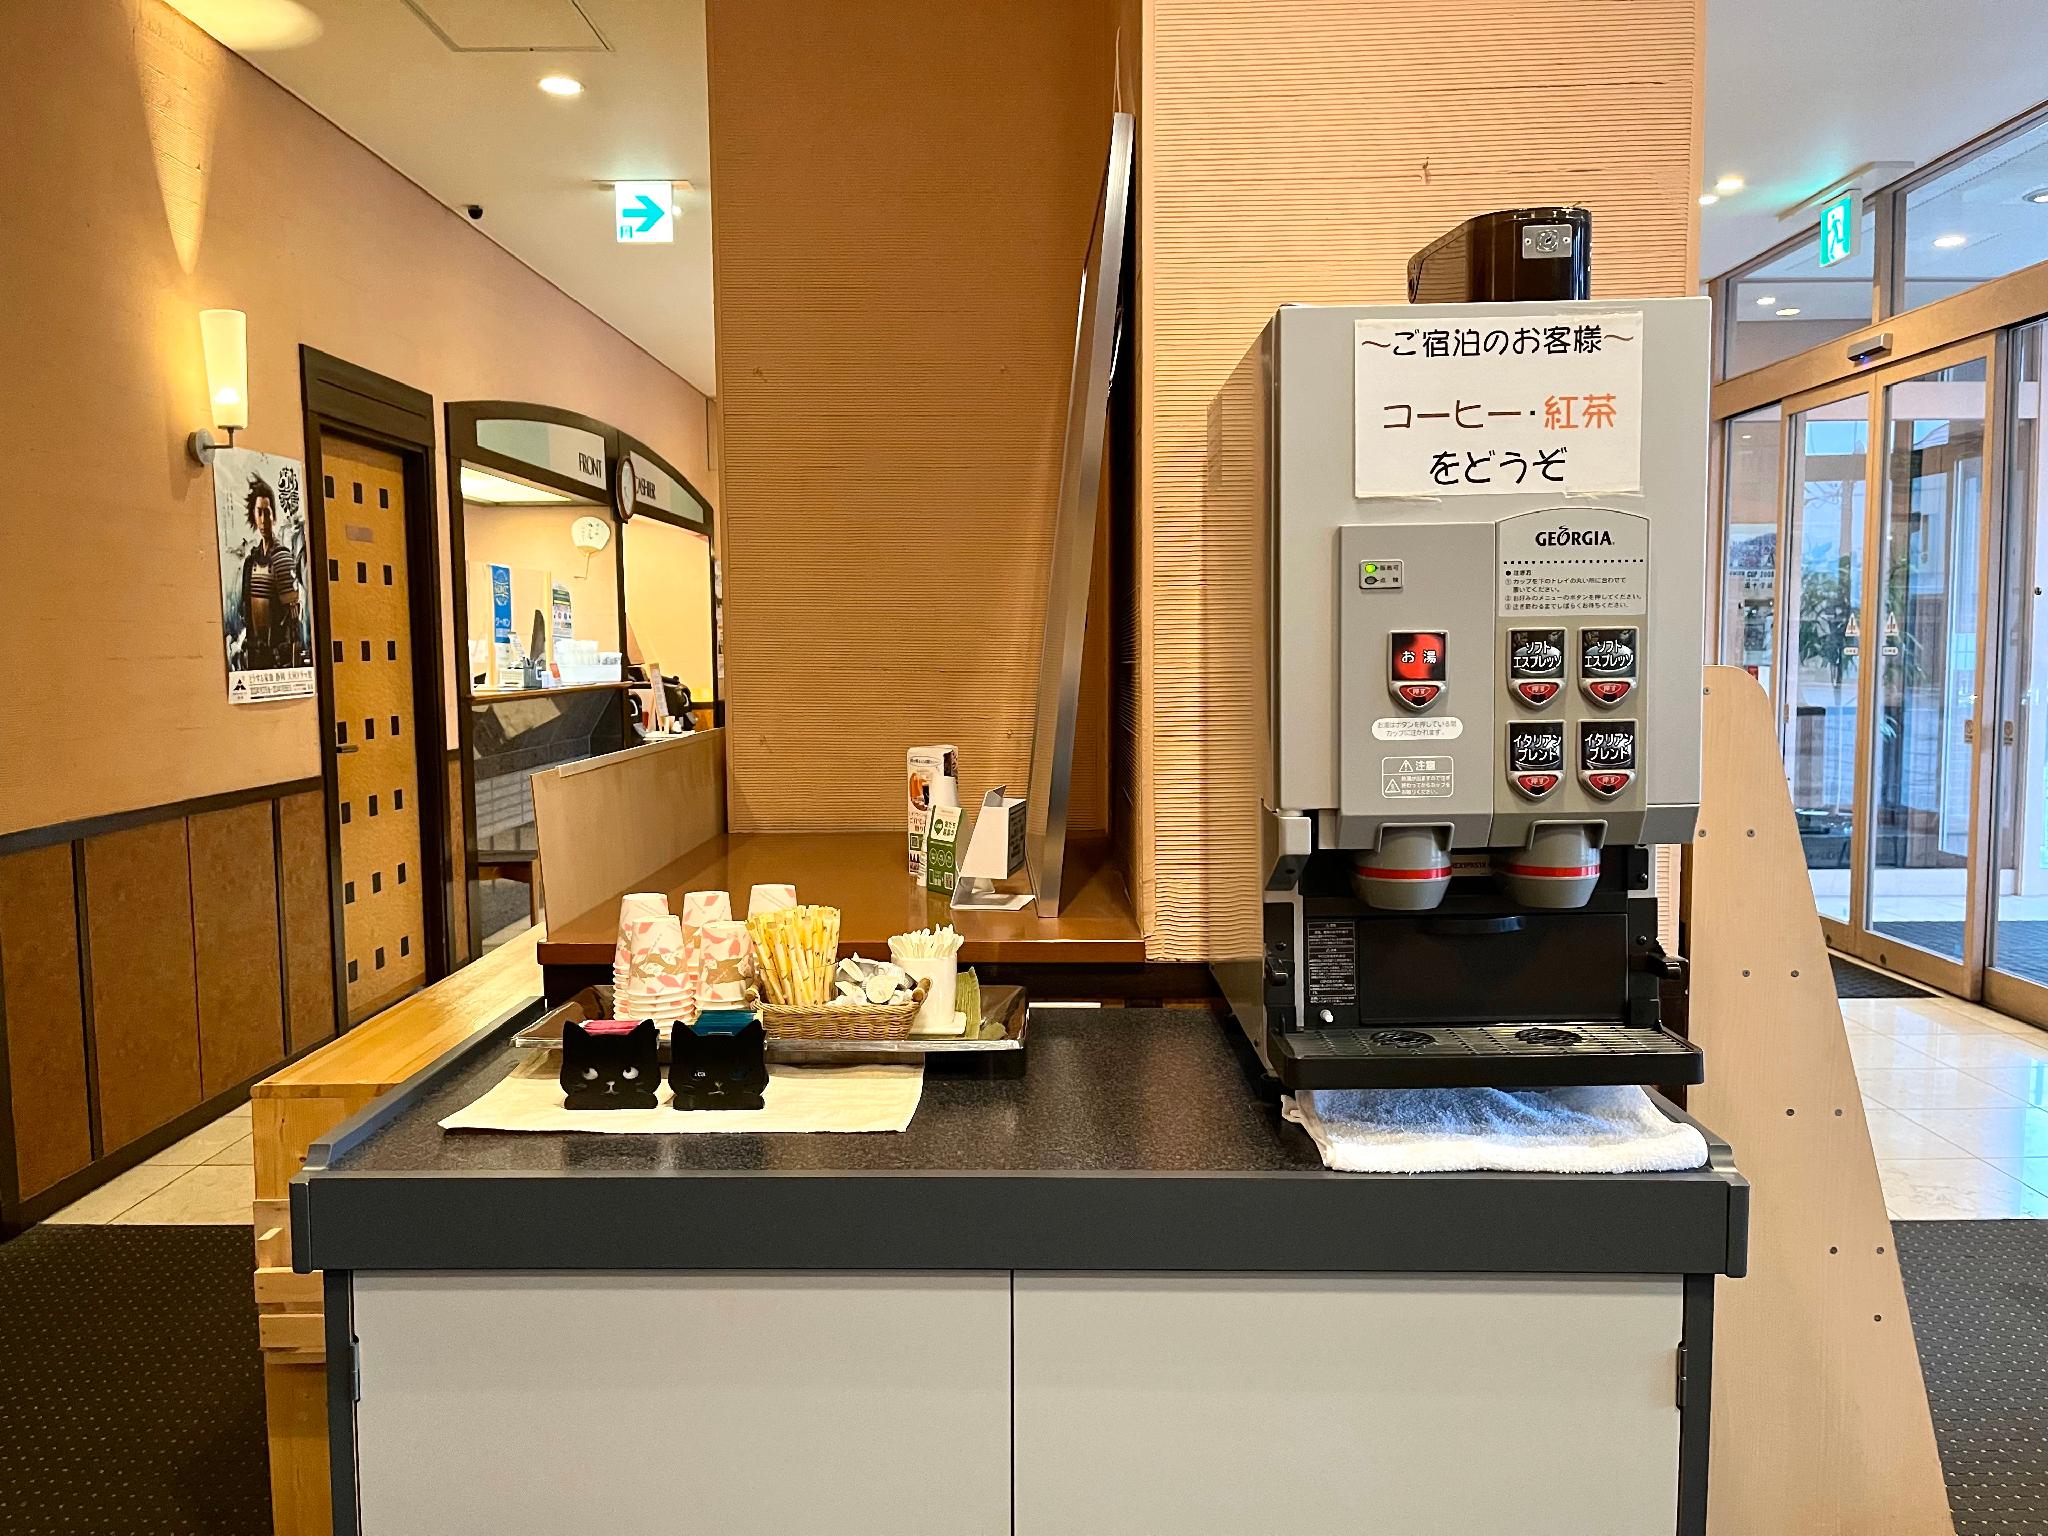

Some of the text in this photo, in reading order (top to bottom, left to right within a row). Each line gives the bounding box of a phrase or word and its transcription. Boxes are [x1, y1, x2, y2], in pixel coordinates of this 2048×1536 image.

[1384, 393, 1617, 430] コーヒー・紅茶
[578, 452, 602, 479] FRONT
[1430, 447, 1567, 485] をどうぞ
[1535, 525, 1613, 547] GEORGIA
[1525, 640, 1551, 654] ソフト
[1597, 639, 1622, 653] ソフト
[1401, 650, 1437, 664] お湯
[1513, 655, 1562, 668] エスプレッソ
[1584, 654, 1634, 668] エスプレッソ
[1513, 733, 1562, 748] イタリアン
[1584, 732, 1634, 747] イタリアン
[1518, 747, 1557, 762] ブレンド
[1589, 746, 1628, 761] ブレンド
